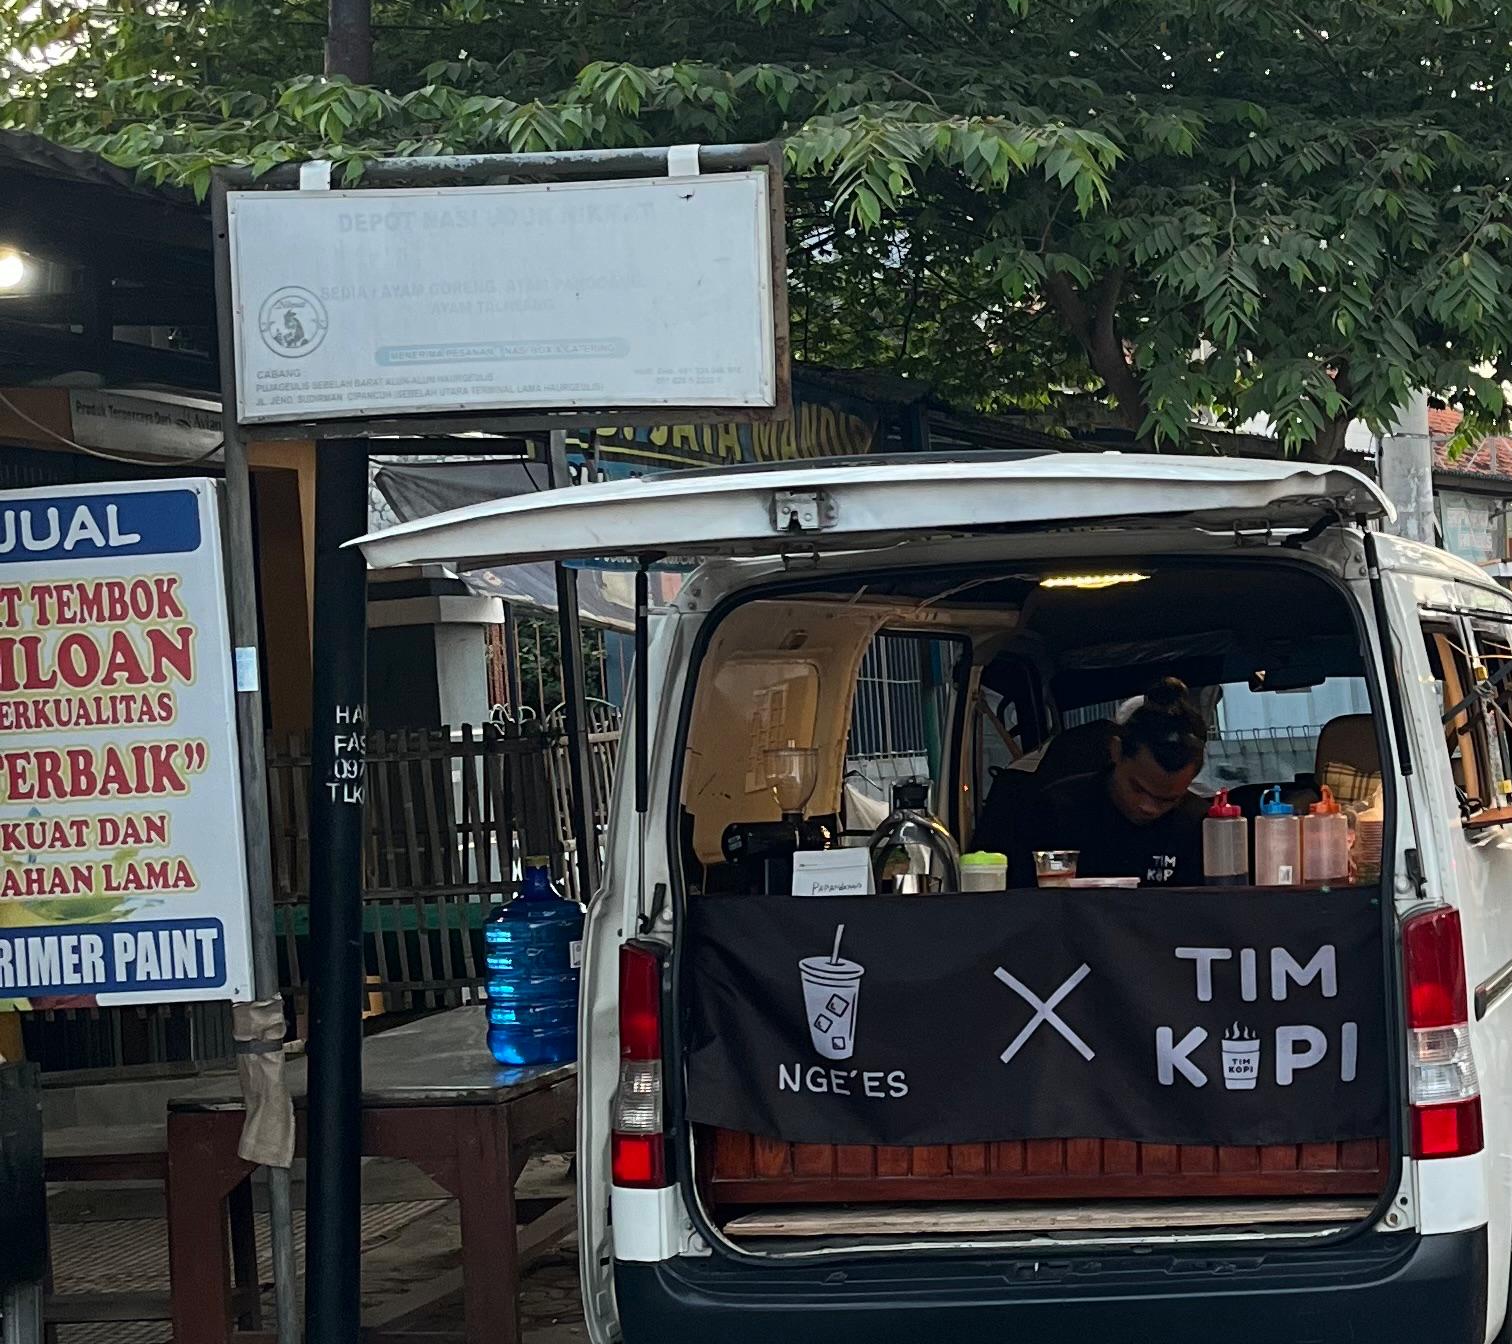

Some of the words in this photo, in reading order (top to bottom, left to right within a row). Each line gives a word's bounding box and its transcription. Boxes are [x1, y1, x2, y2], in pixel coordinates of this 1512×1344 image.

[338, 212, 414, 233] DEPOT
[31, 578, 183, 626] TEMBOK
[1, 821, 90, 851] KUAT
[98, 816, 168, 847] DAN
[102, 860, 196, 893] LAMA
[0, 934, 106, 988] RIMER
[114, 927, 218, 984] PAINT
[1175, 944, 1338, 1002] TIM
[1156, 1021, 1358, 1087] KPI
[1229, 1066, 1254, 1074] KOPI
[1232, 1058, 1250, 1066] TIM
